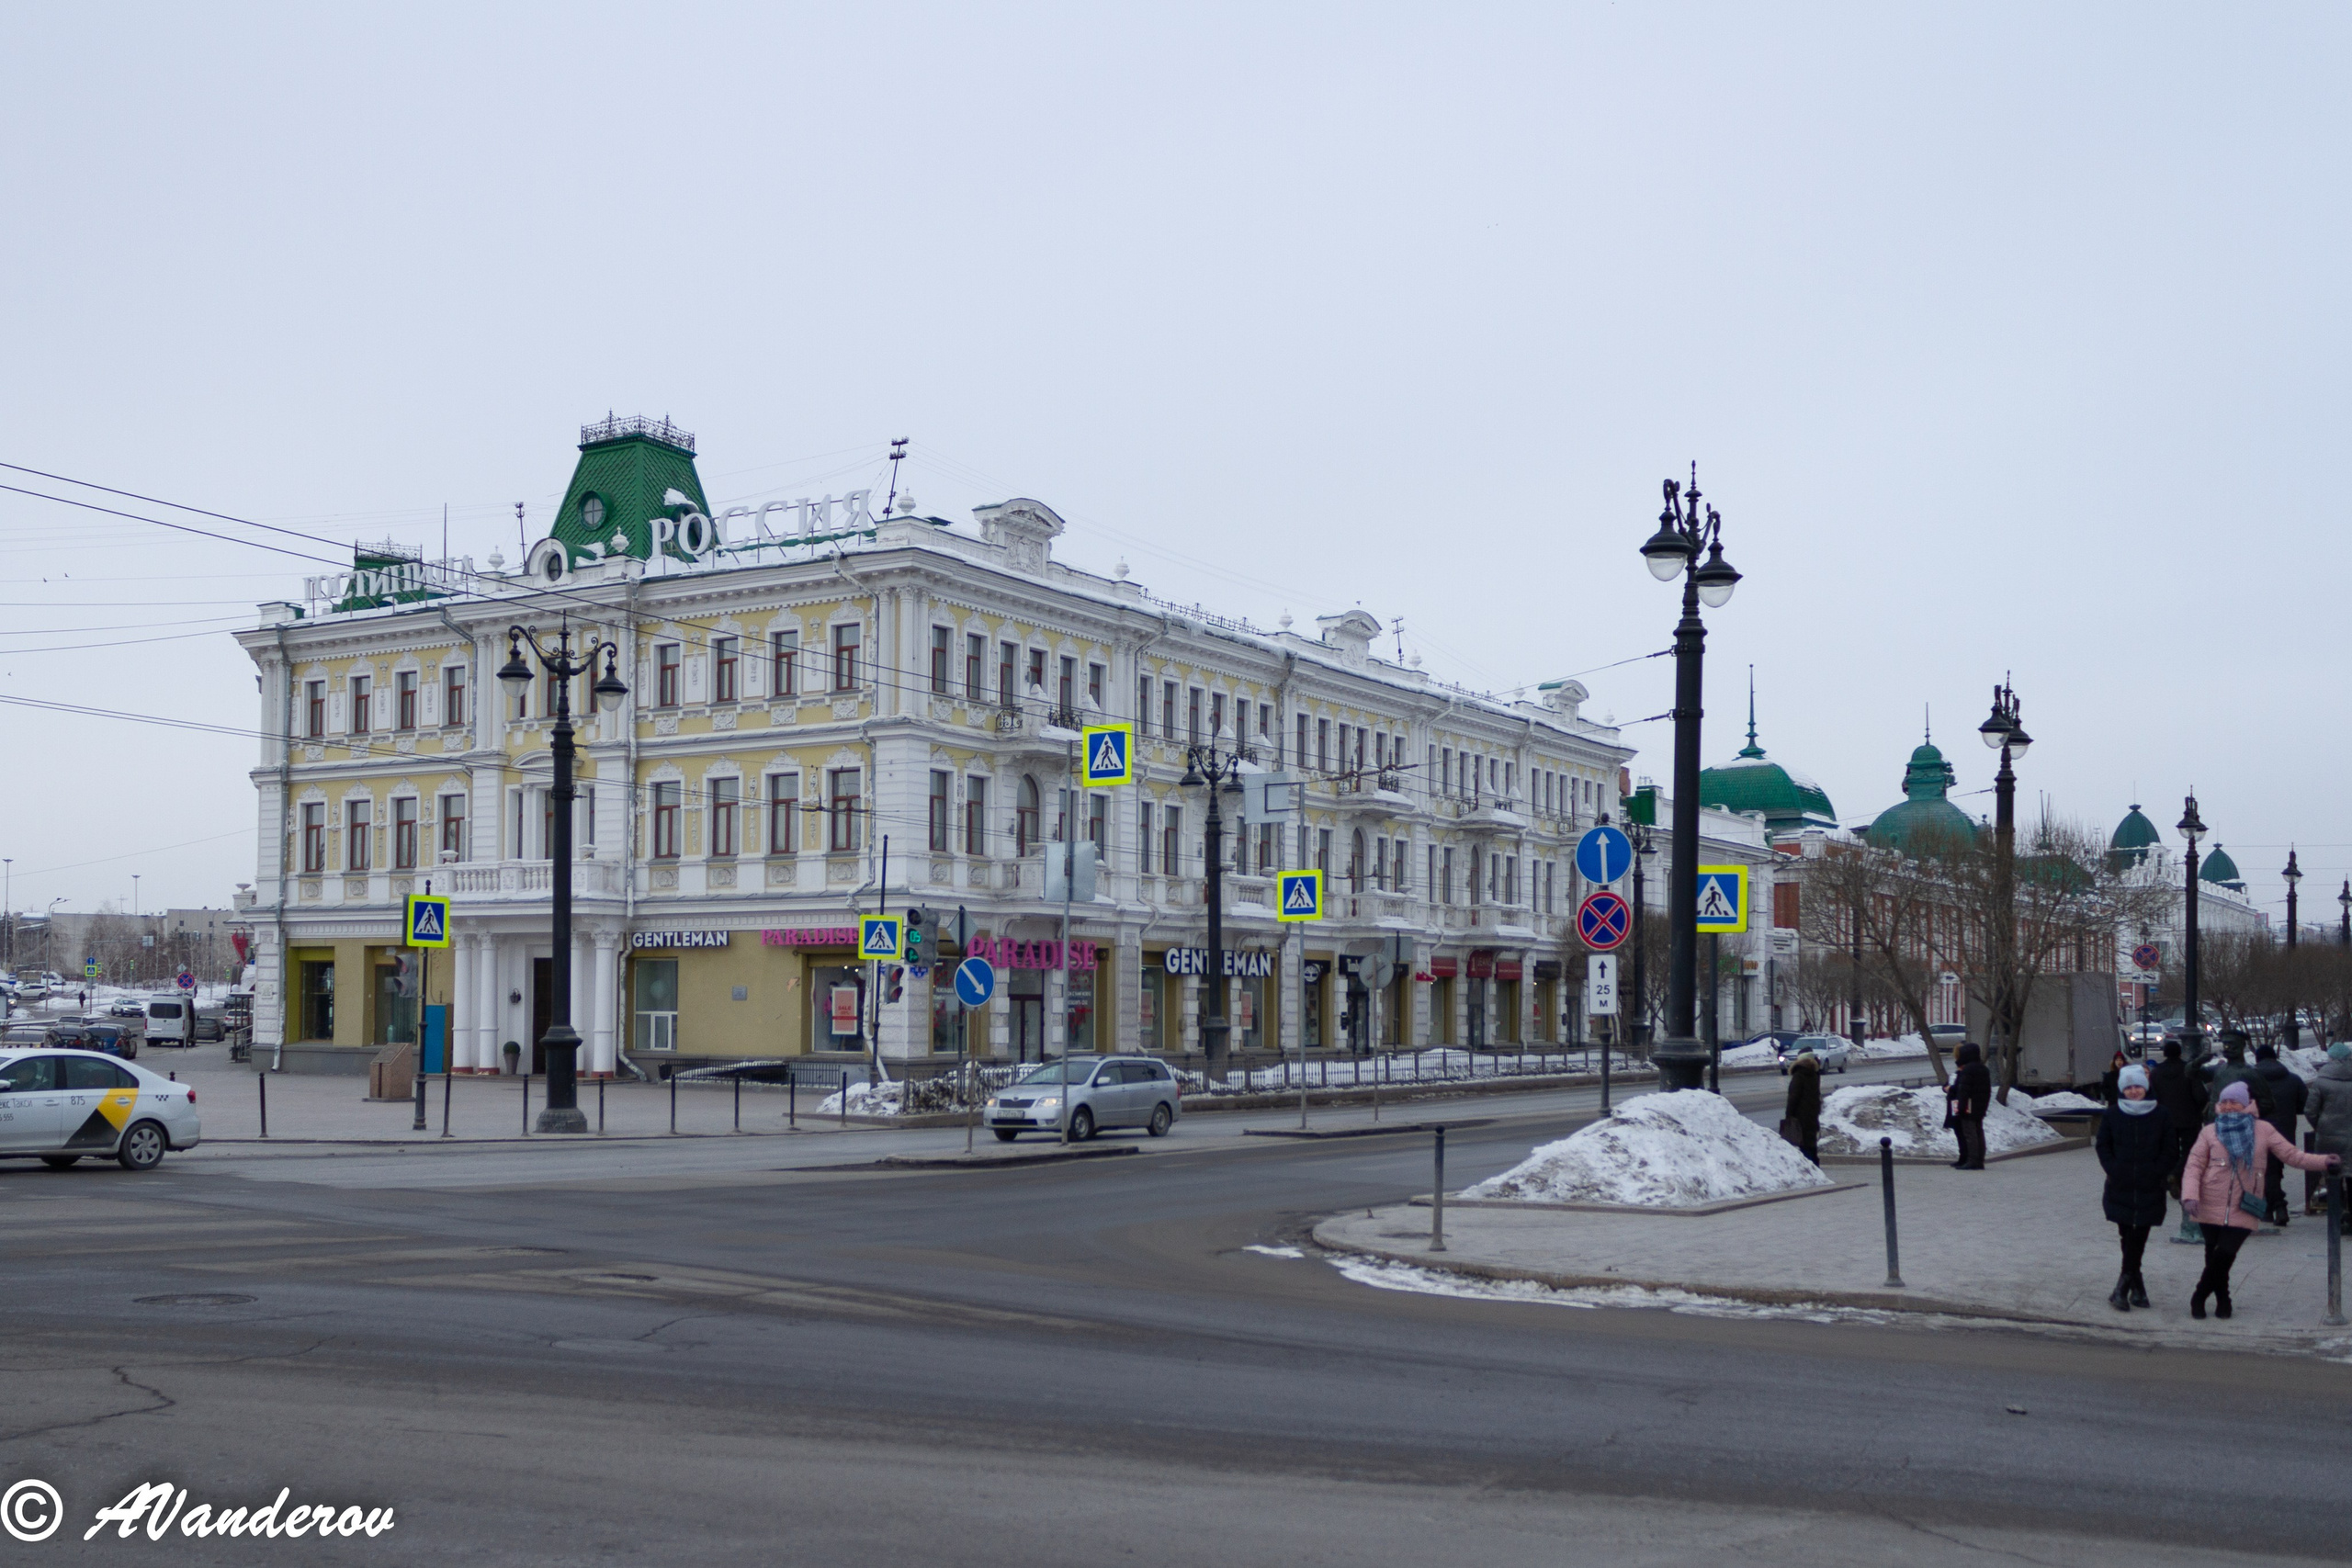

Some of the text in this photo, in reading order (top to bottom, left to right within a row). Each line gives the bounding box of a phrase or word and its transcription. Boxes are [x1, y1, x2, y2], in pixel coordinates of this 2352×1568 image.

[649, 489, 872, 559] РОССИЯ
[303, 555, 479, 603] ГОСТИНИЦА
[632, 931, 729, 948] GENTLEMAN
[761, 927, 859, 946] PARADISE
[967, 935, 1099, 970] PARADISE
[1166, 947, 1272, 976] GENTEMAN
[1597, 985, 1611, 995] 25
[71, 1096, 85, 1105] 875
